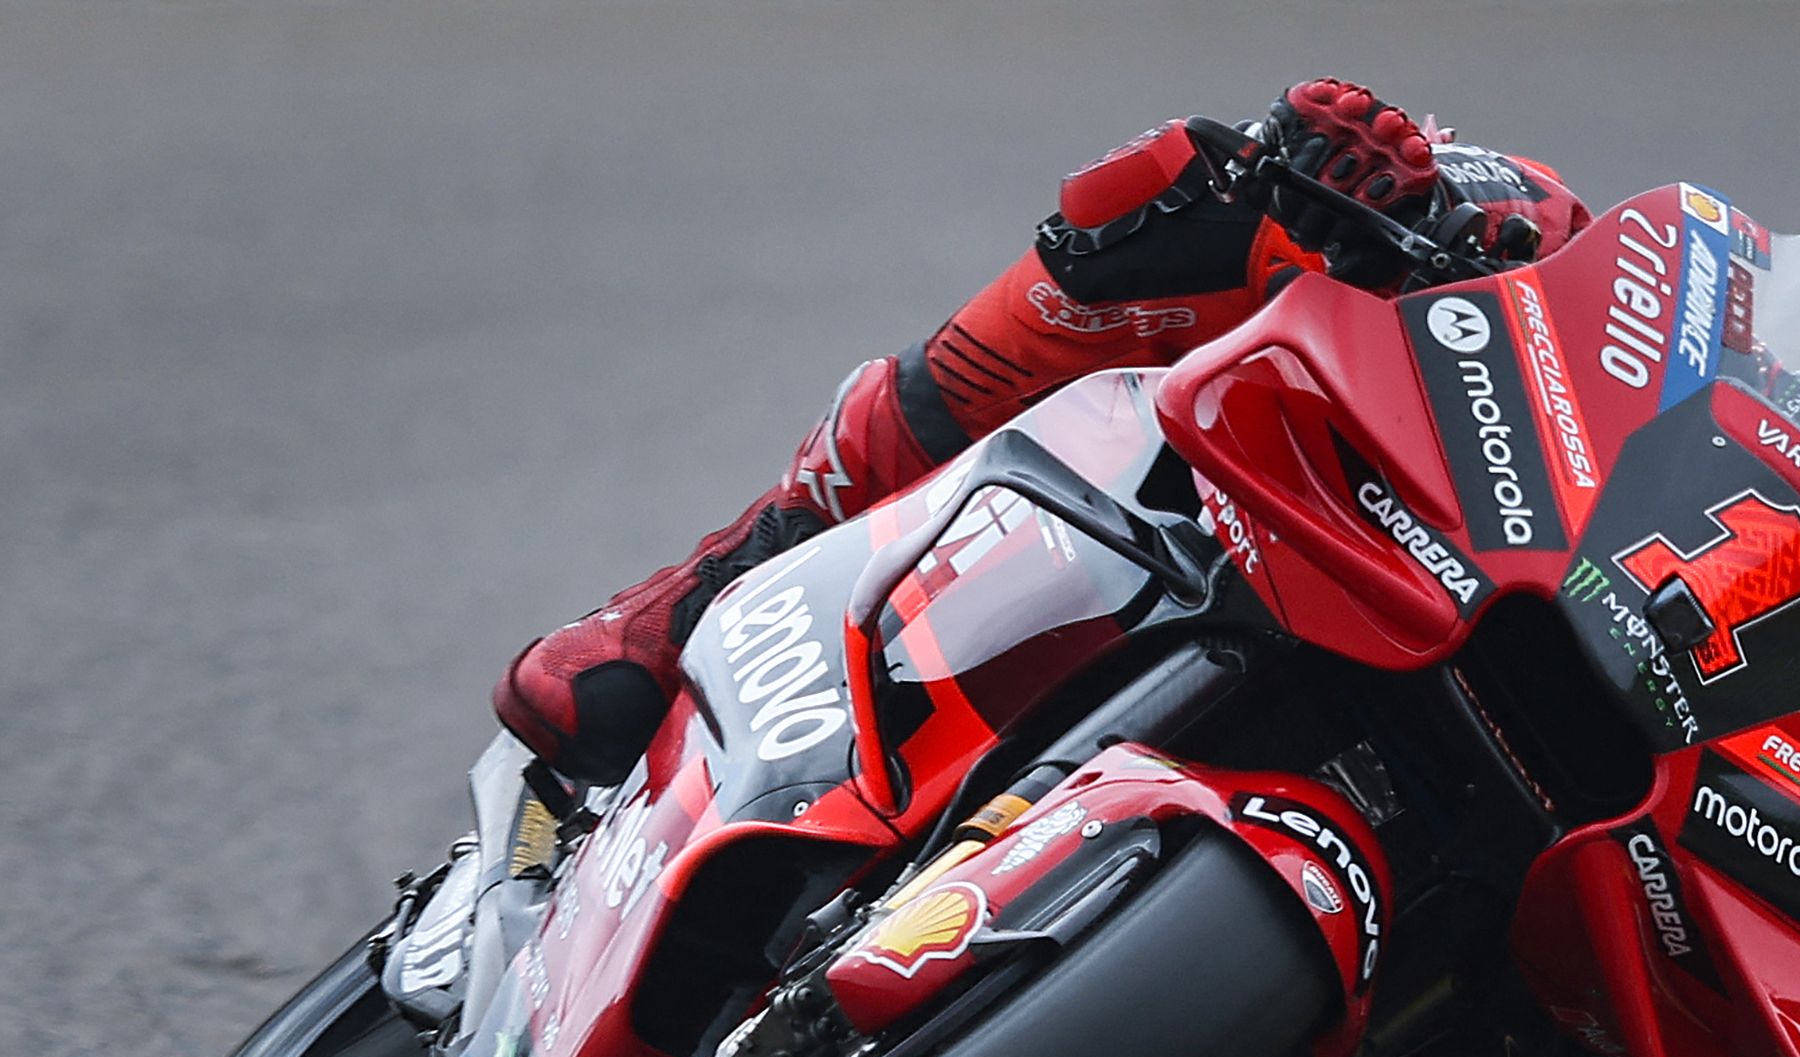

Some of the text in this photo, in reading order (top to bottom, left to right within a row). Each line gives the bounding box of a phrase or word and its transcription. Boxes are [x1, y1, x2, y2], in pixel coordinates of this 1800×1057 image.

[1457, 360, 1534, 545] motorola
[1515, 279, 1597, 489] FRECCIAROSSA
[1358, 482, 1480, 604] CARRERA
[719, 546, 848, 761] Lenovo
[1601, 592, 1699, 745] MONSTER
[1242, 796, 1379, 979] Lenovo
[1628, 833, 1692, 957] CARRERA
